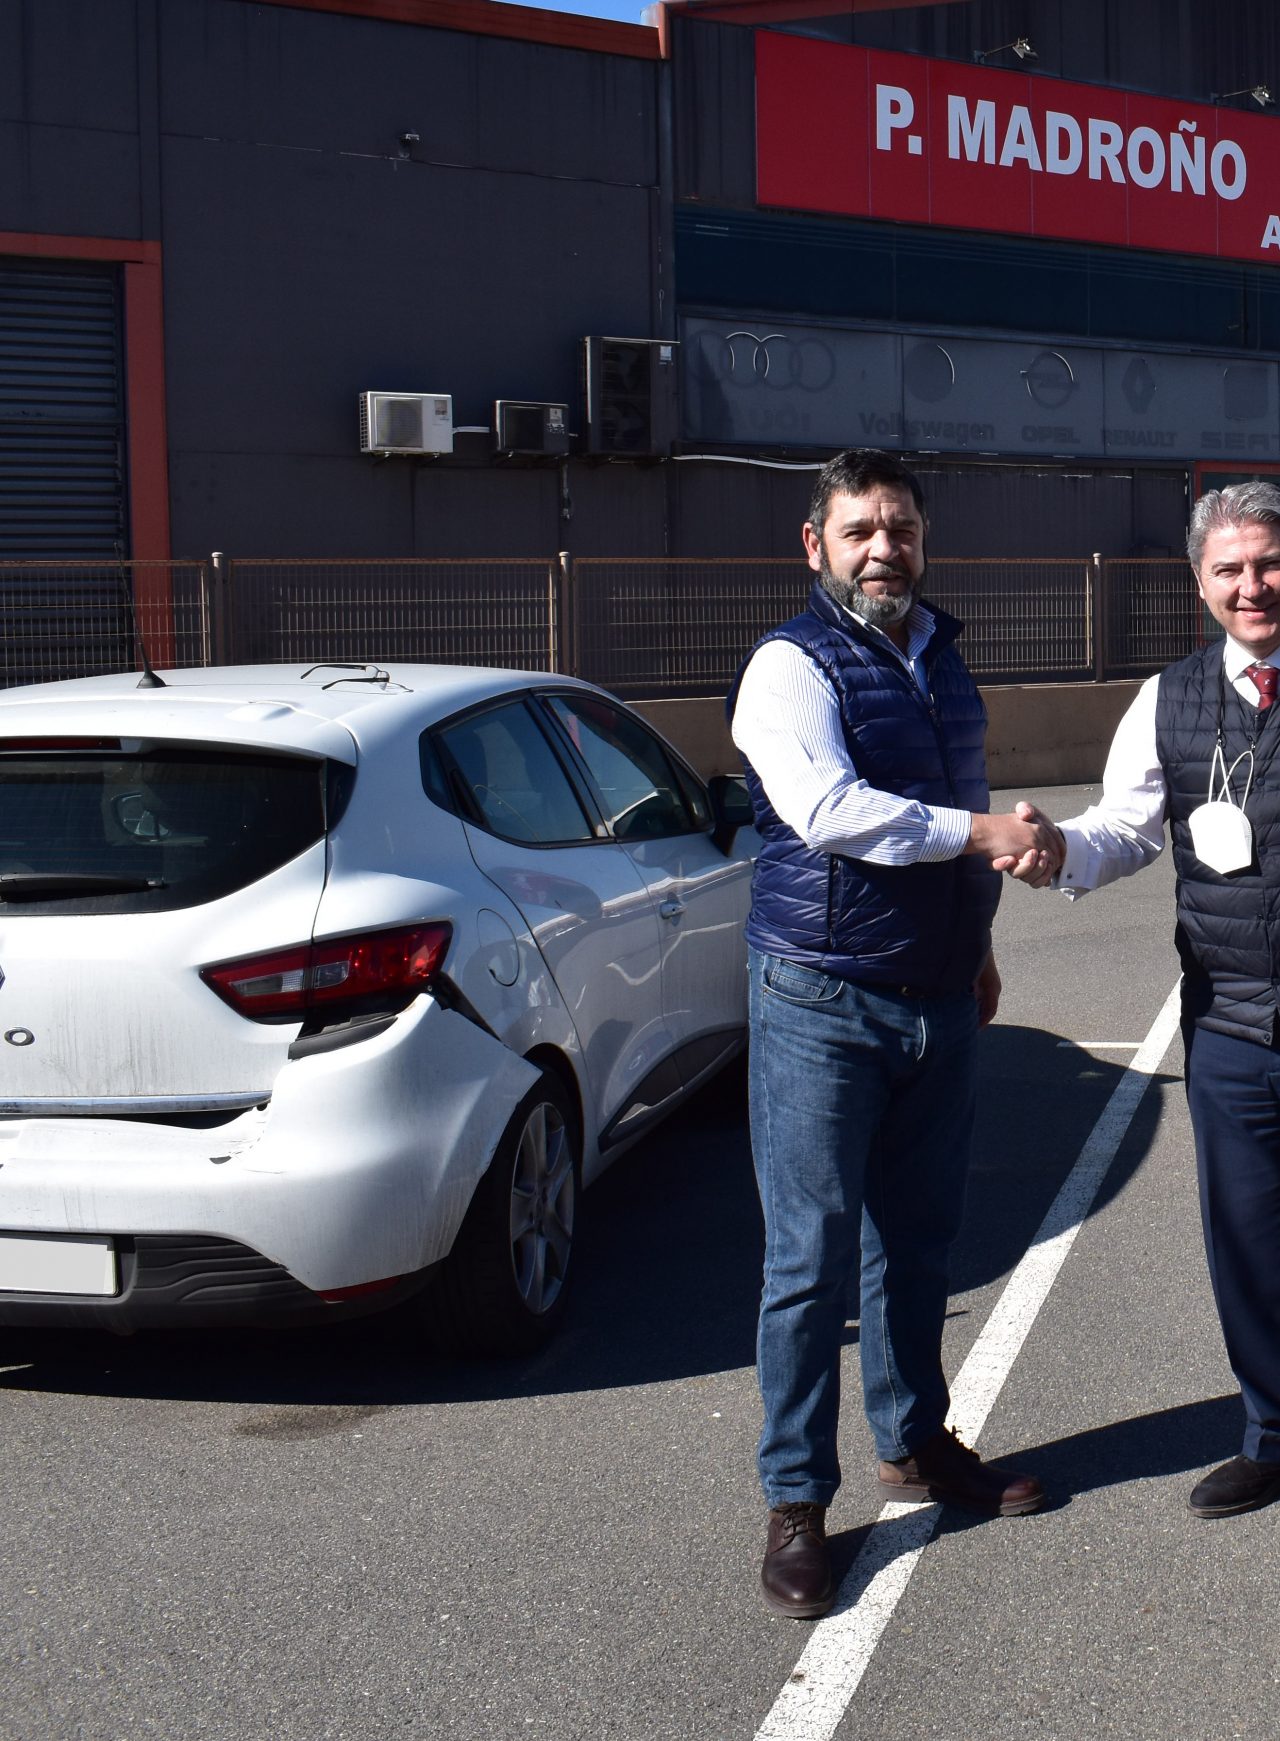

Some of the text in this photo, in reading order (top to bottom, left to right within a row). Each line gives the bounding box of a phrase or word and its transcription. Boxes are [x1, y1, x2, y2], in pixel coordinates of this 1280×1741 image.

[876, 84, 1247, 200] P. MADROÑO
[1021, 423, 1081, 444] OPEL
